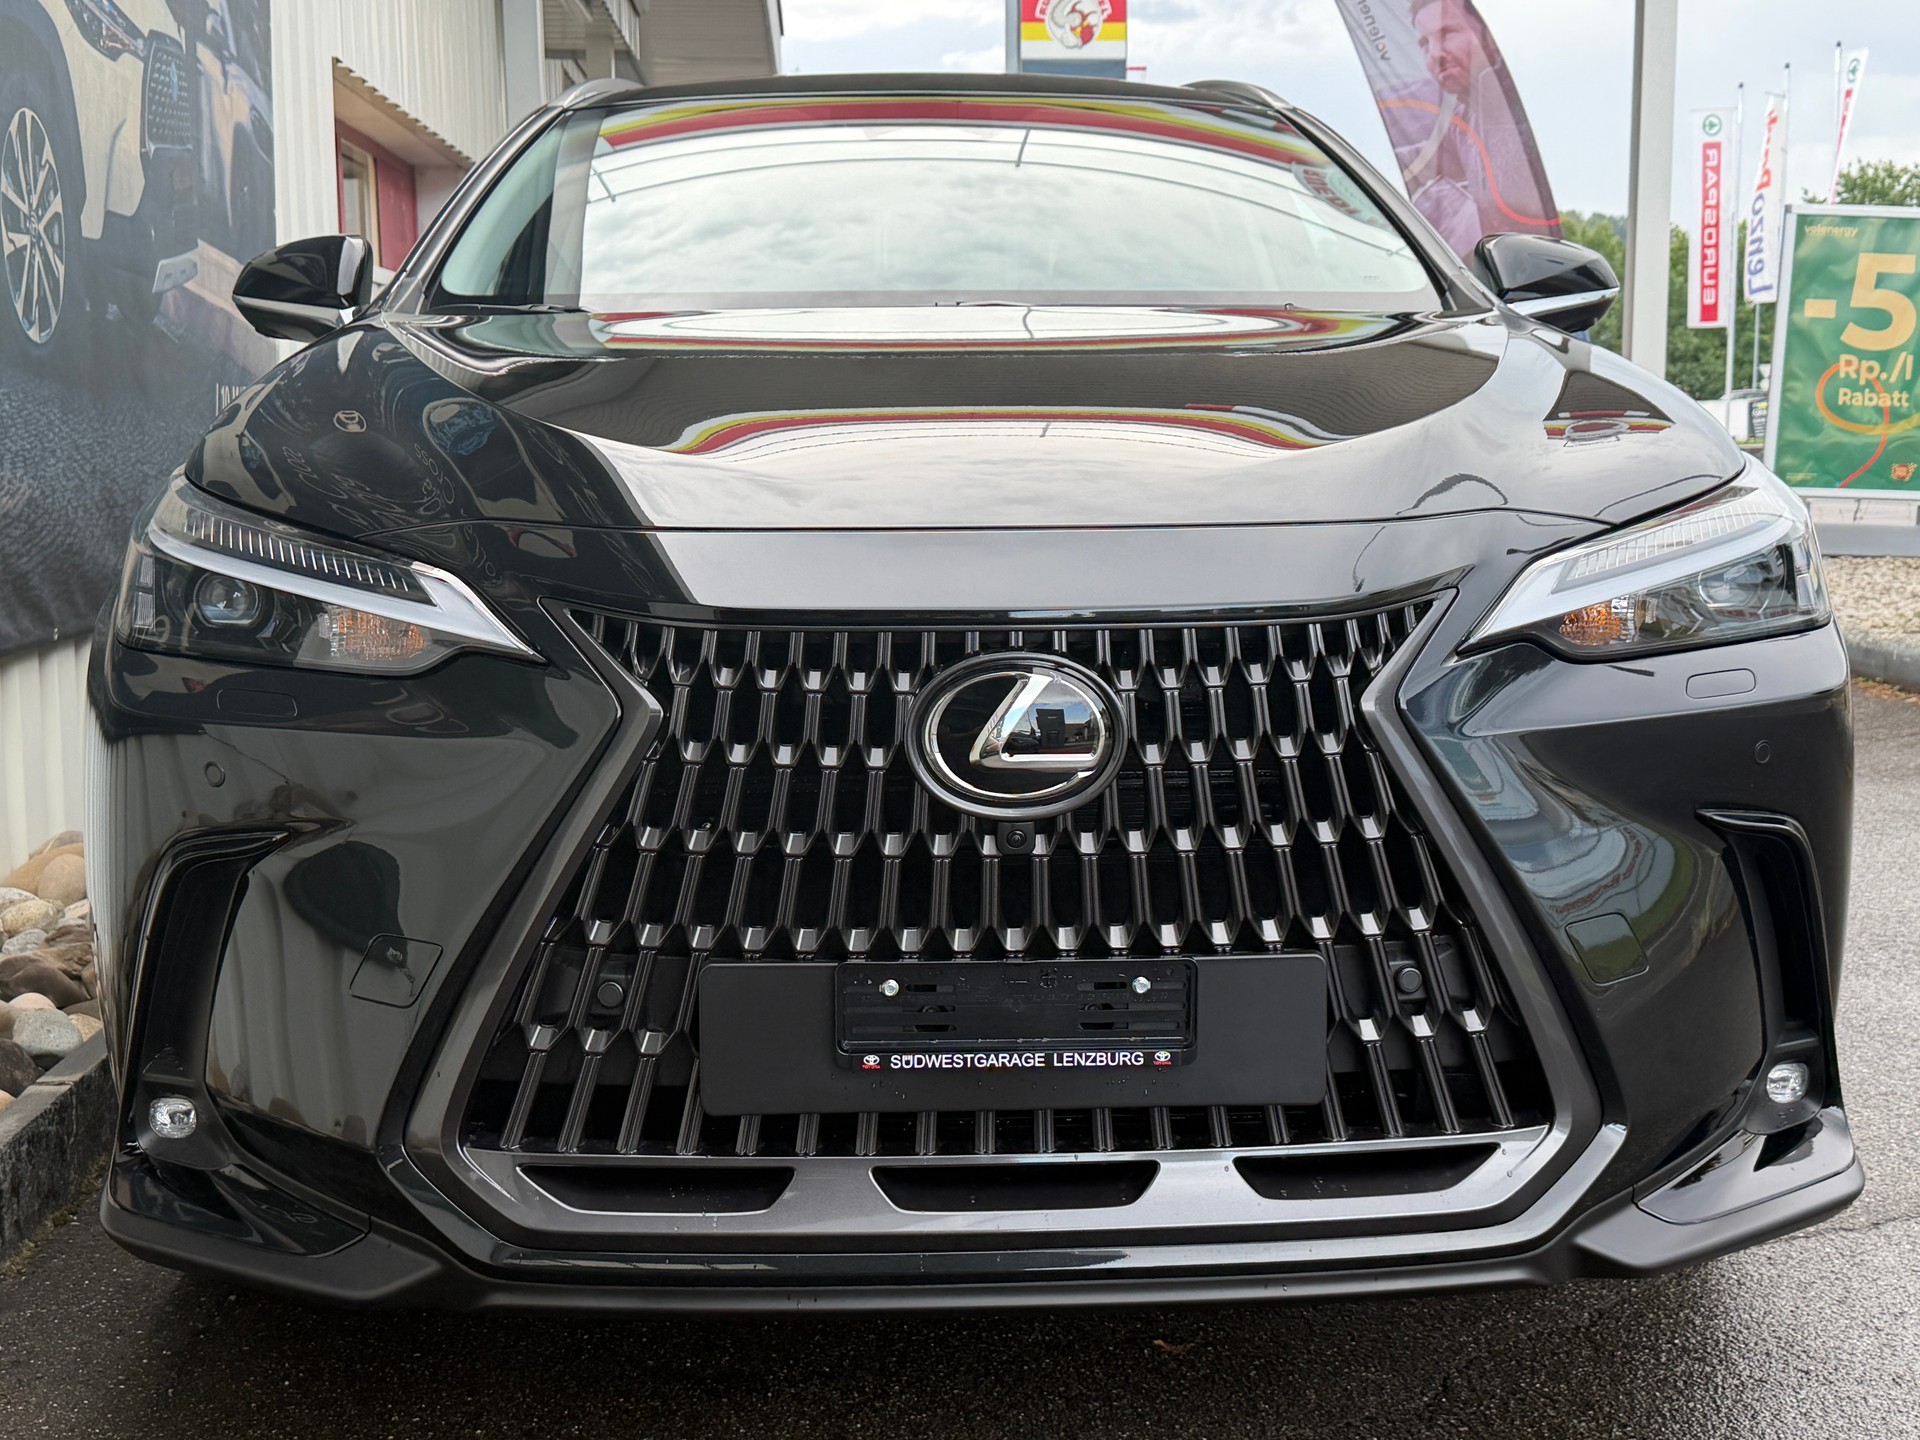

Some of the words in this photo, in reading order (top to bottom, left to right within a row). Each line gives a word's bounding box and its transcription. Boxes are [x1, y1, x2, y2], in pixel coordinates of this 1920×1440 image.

[1804, 224, 1858, 238] volenergy
[1804, 253, 1917, 351] -5
[1837, 388, 1910, 407] Rabatt
[890, 1053, 1045, 1069] SÜDWESTGARAGE
[1053, 1051, 1144, 1067] LENZBURG
